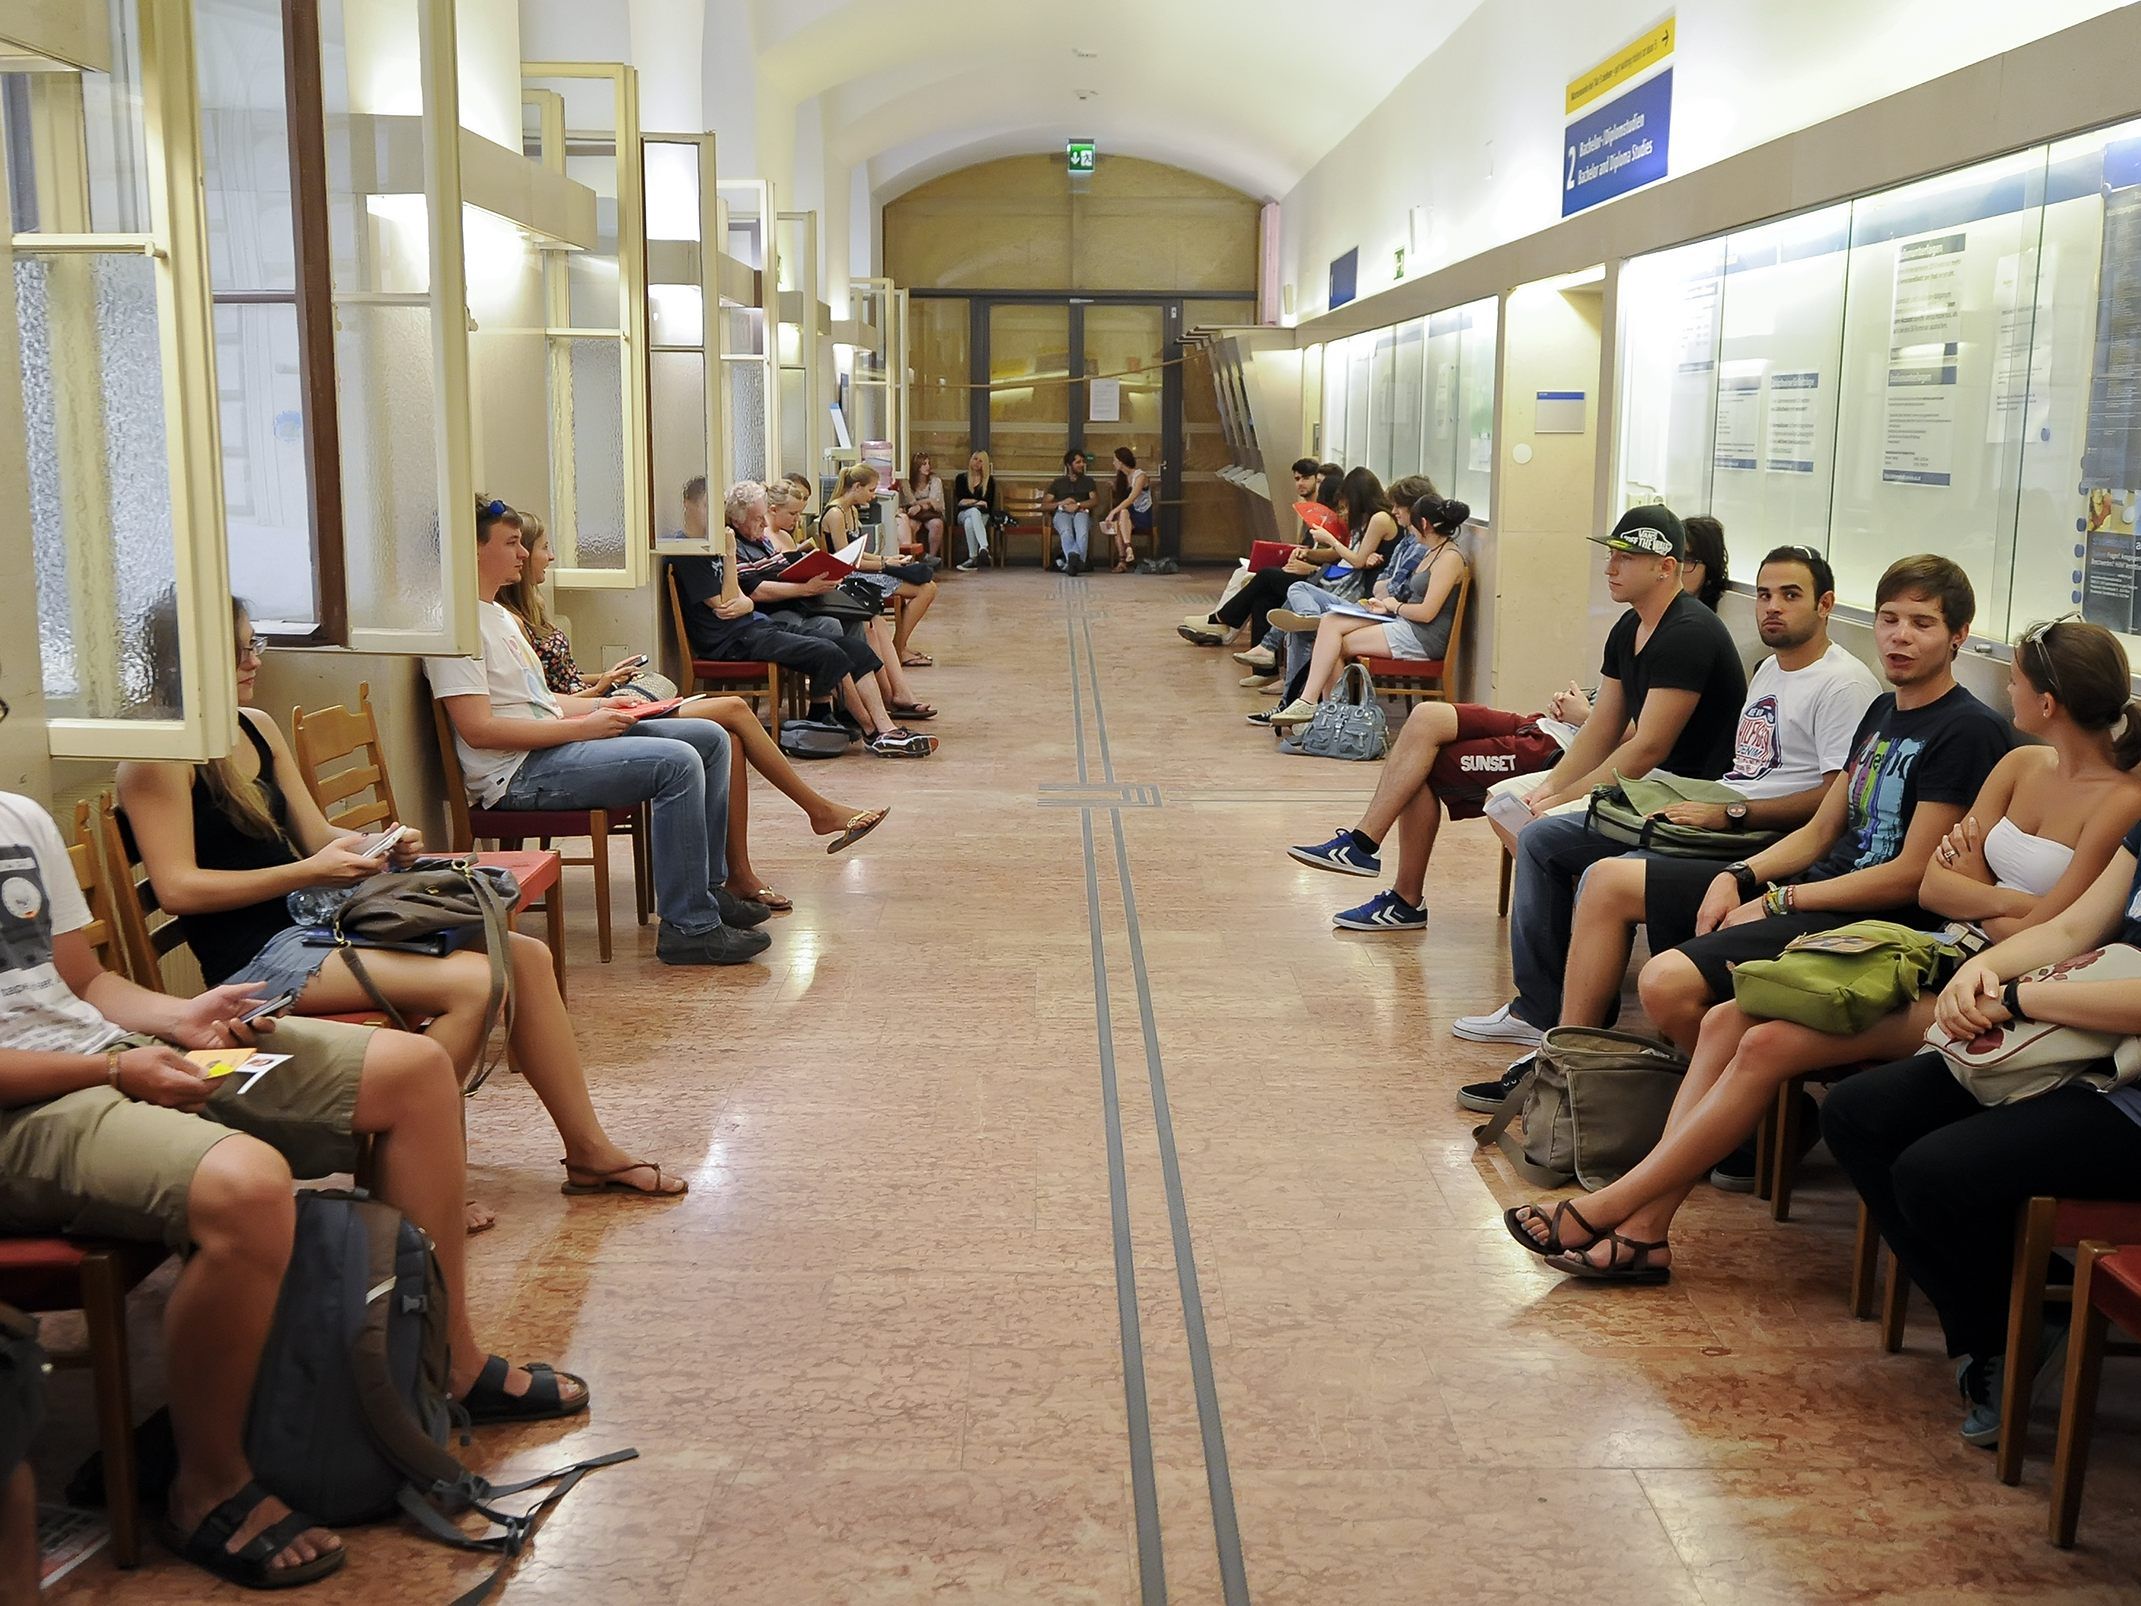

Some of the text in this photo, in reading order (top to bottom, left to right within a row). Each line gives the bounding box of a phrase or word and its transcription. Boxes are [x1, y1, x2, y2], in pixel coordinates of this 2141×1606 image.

[1567, 145, 1577, 190] 2
[1599, 155, 1609, 176] and
[1631, 138, 1653, 162] Studies
[1460, 754, 1516, 771] SUNSET
